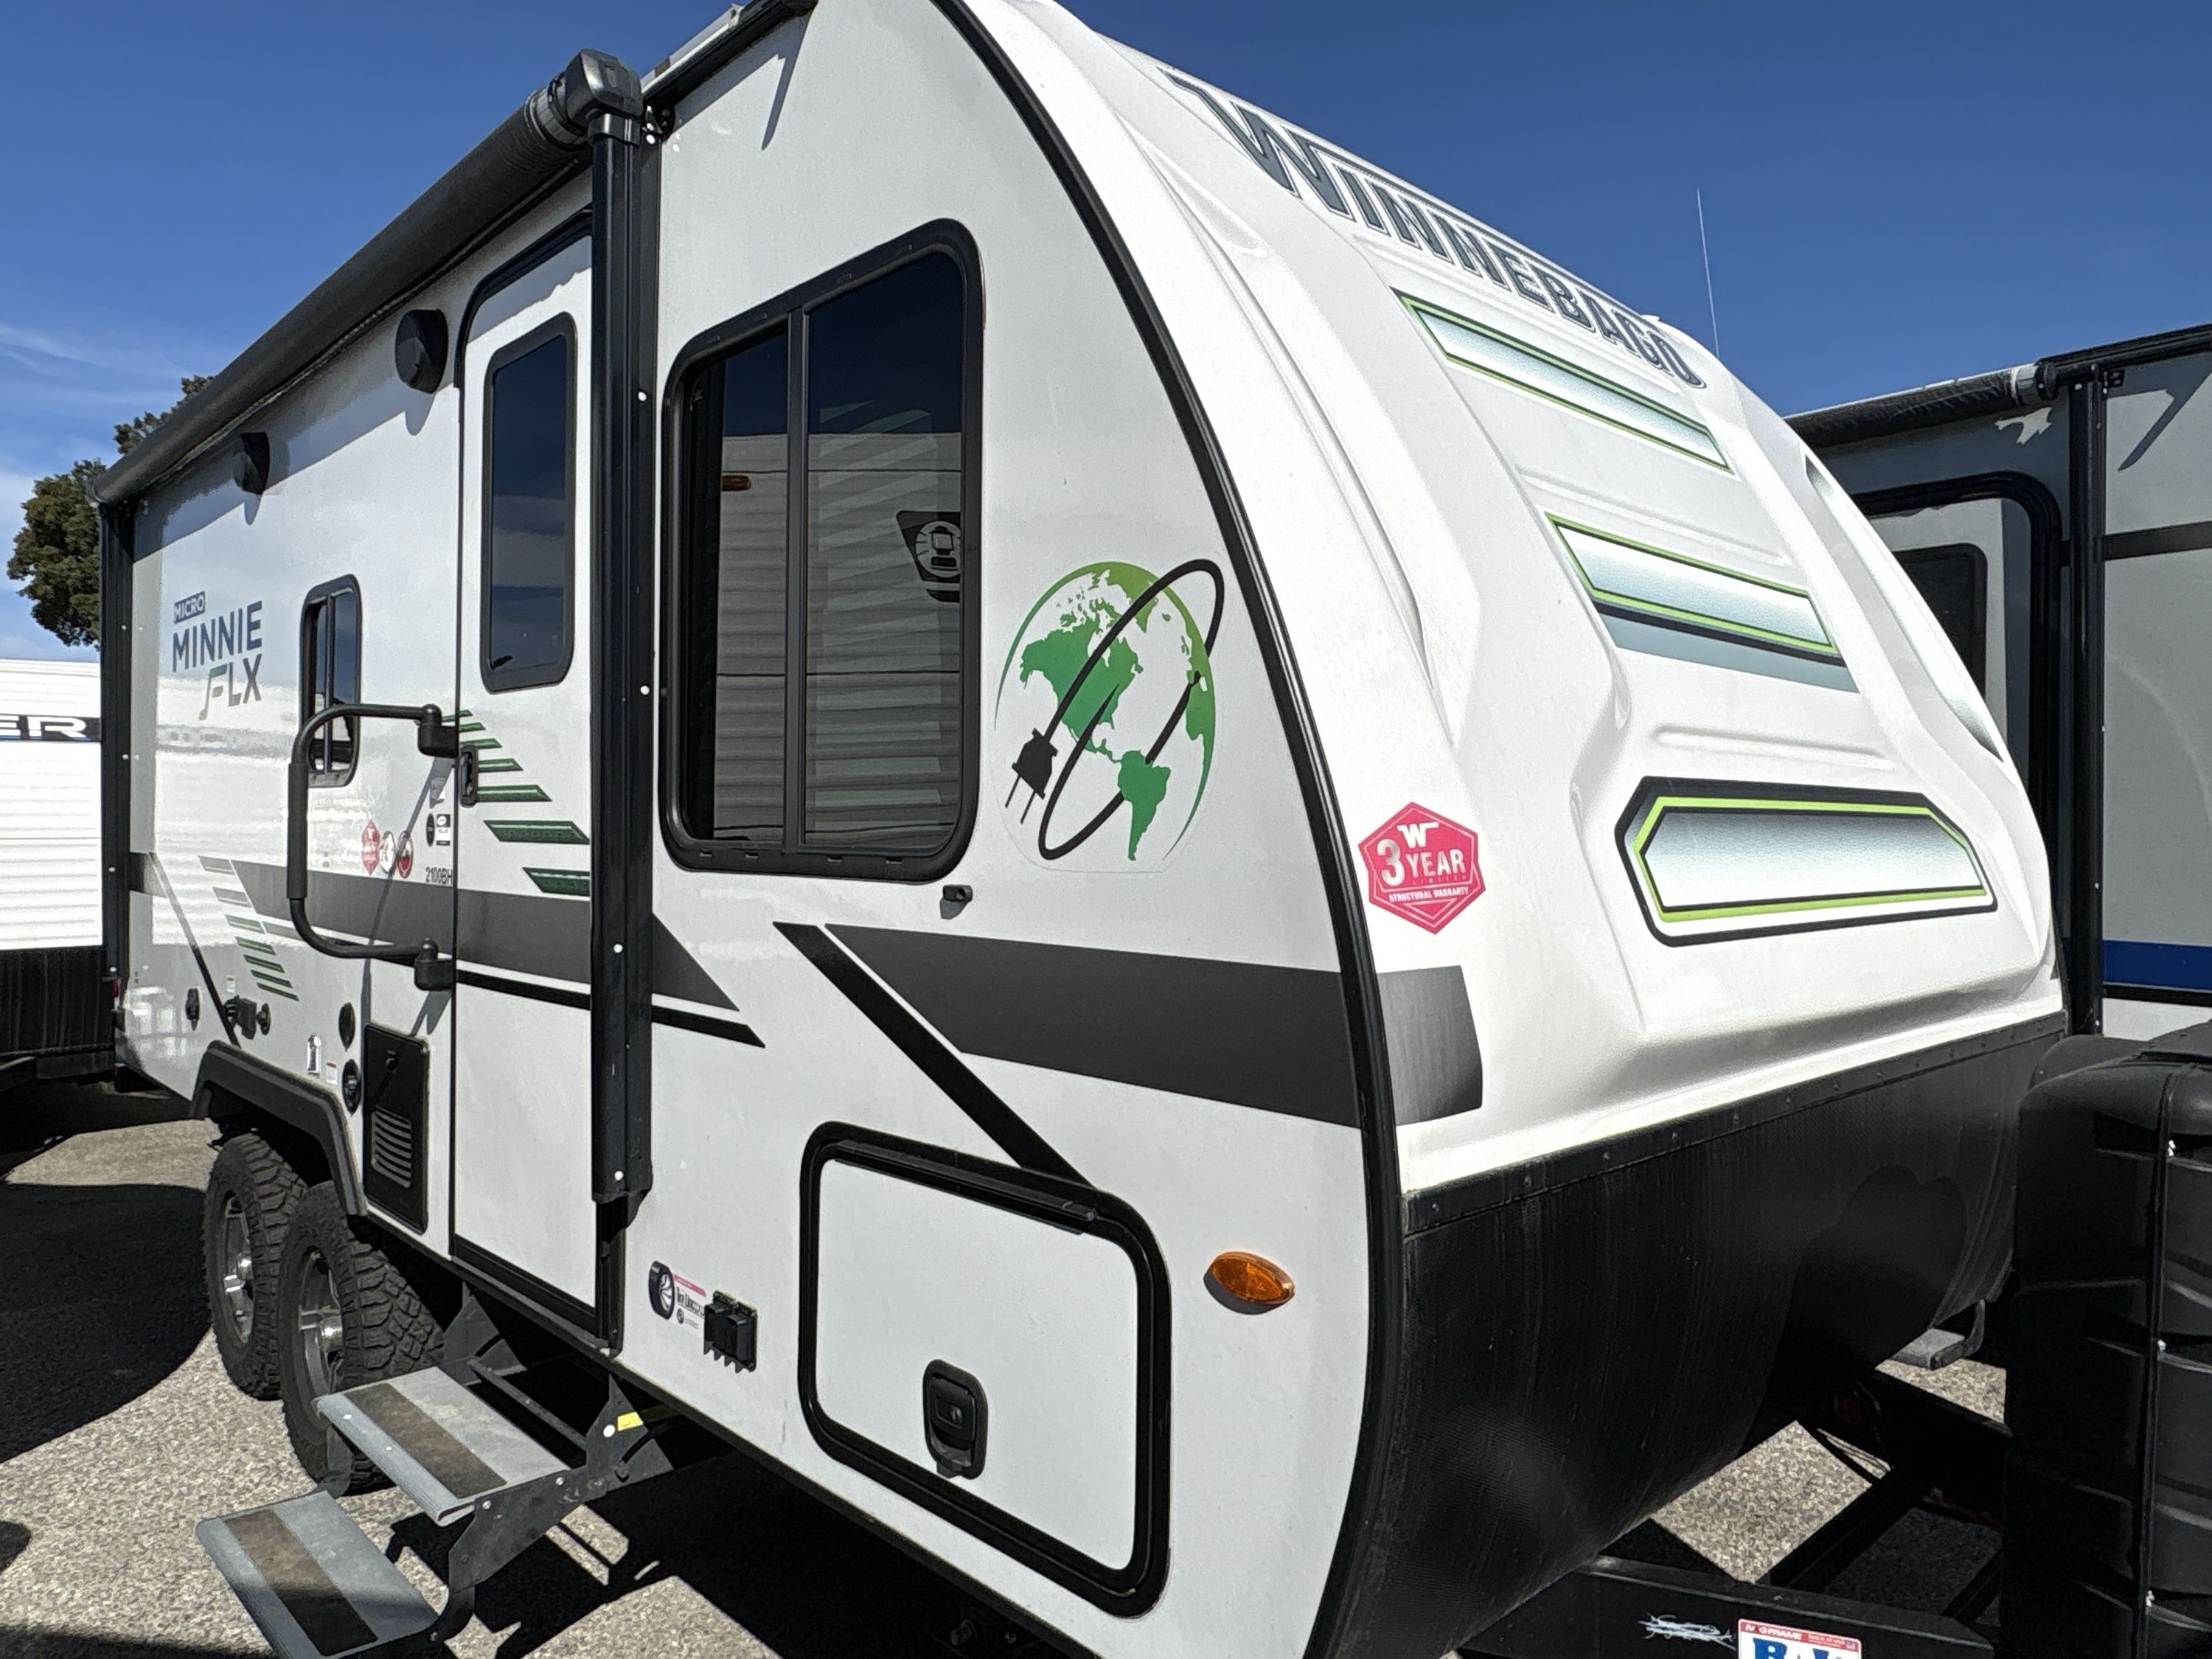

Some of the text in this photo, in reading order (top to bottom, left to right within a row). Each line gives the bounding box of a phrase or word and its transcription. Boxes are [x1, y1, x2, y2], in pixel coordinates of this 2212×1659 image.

[1156, 66, 1707, 389] WINNEBAGO
[172, 600, 262, 673] MINNIE
[174, 594, 205, 622] MICRO
[198, 653, 262, 721] FLX
[1376, 838, 1467, 886] 3 YEAR
[1388, 886, 1469, 902] STRUCTURAL WARRANTY
